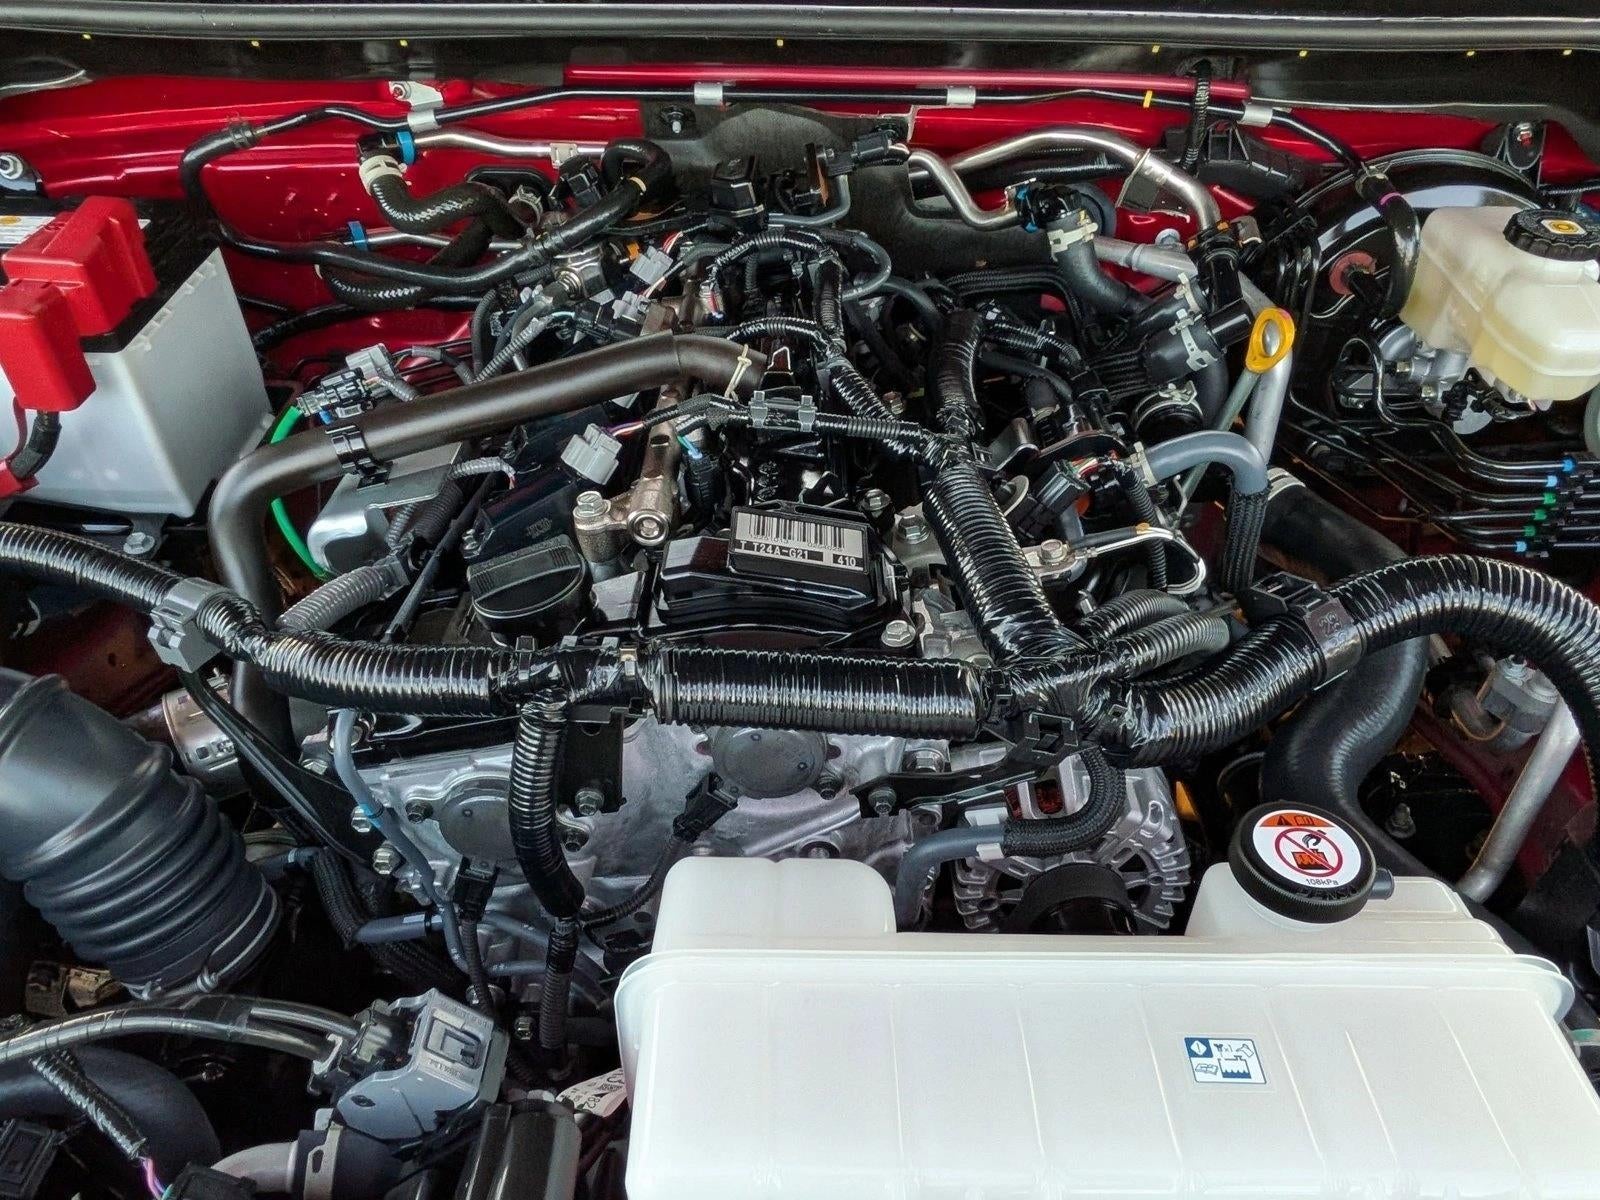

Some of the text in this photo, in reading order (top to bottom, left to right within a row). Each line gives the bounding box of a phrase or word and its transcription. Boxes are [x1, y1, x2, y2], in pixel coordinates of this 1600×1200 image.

[753, 543, 809, 560] T24A-G21
[837, 557, 857, 567] 410
[1306, 878, 1339, 886] 108kPa
